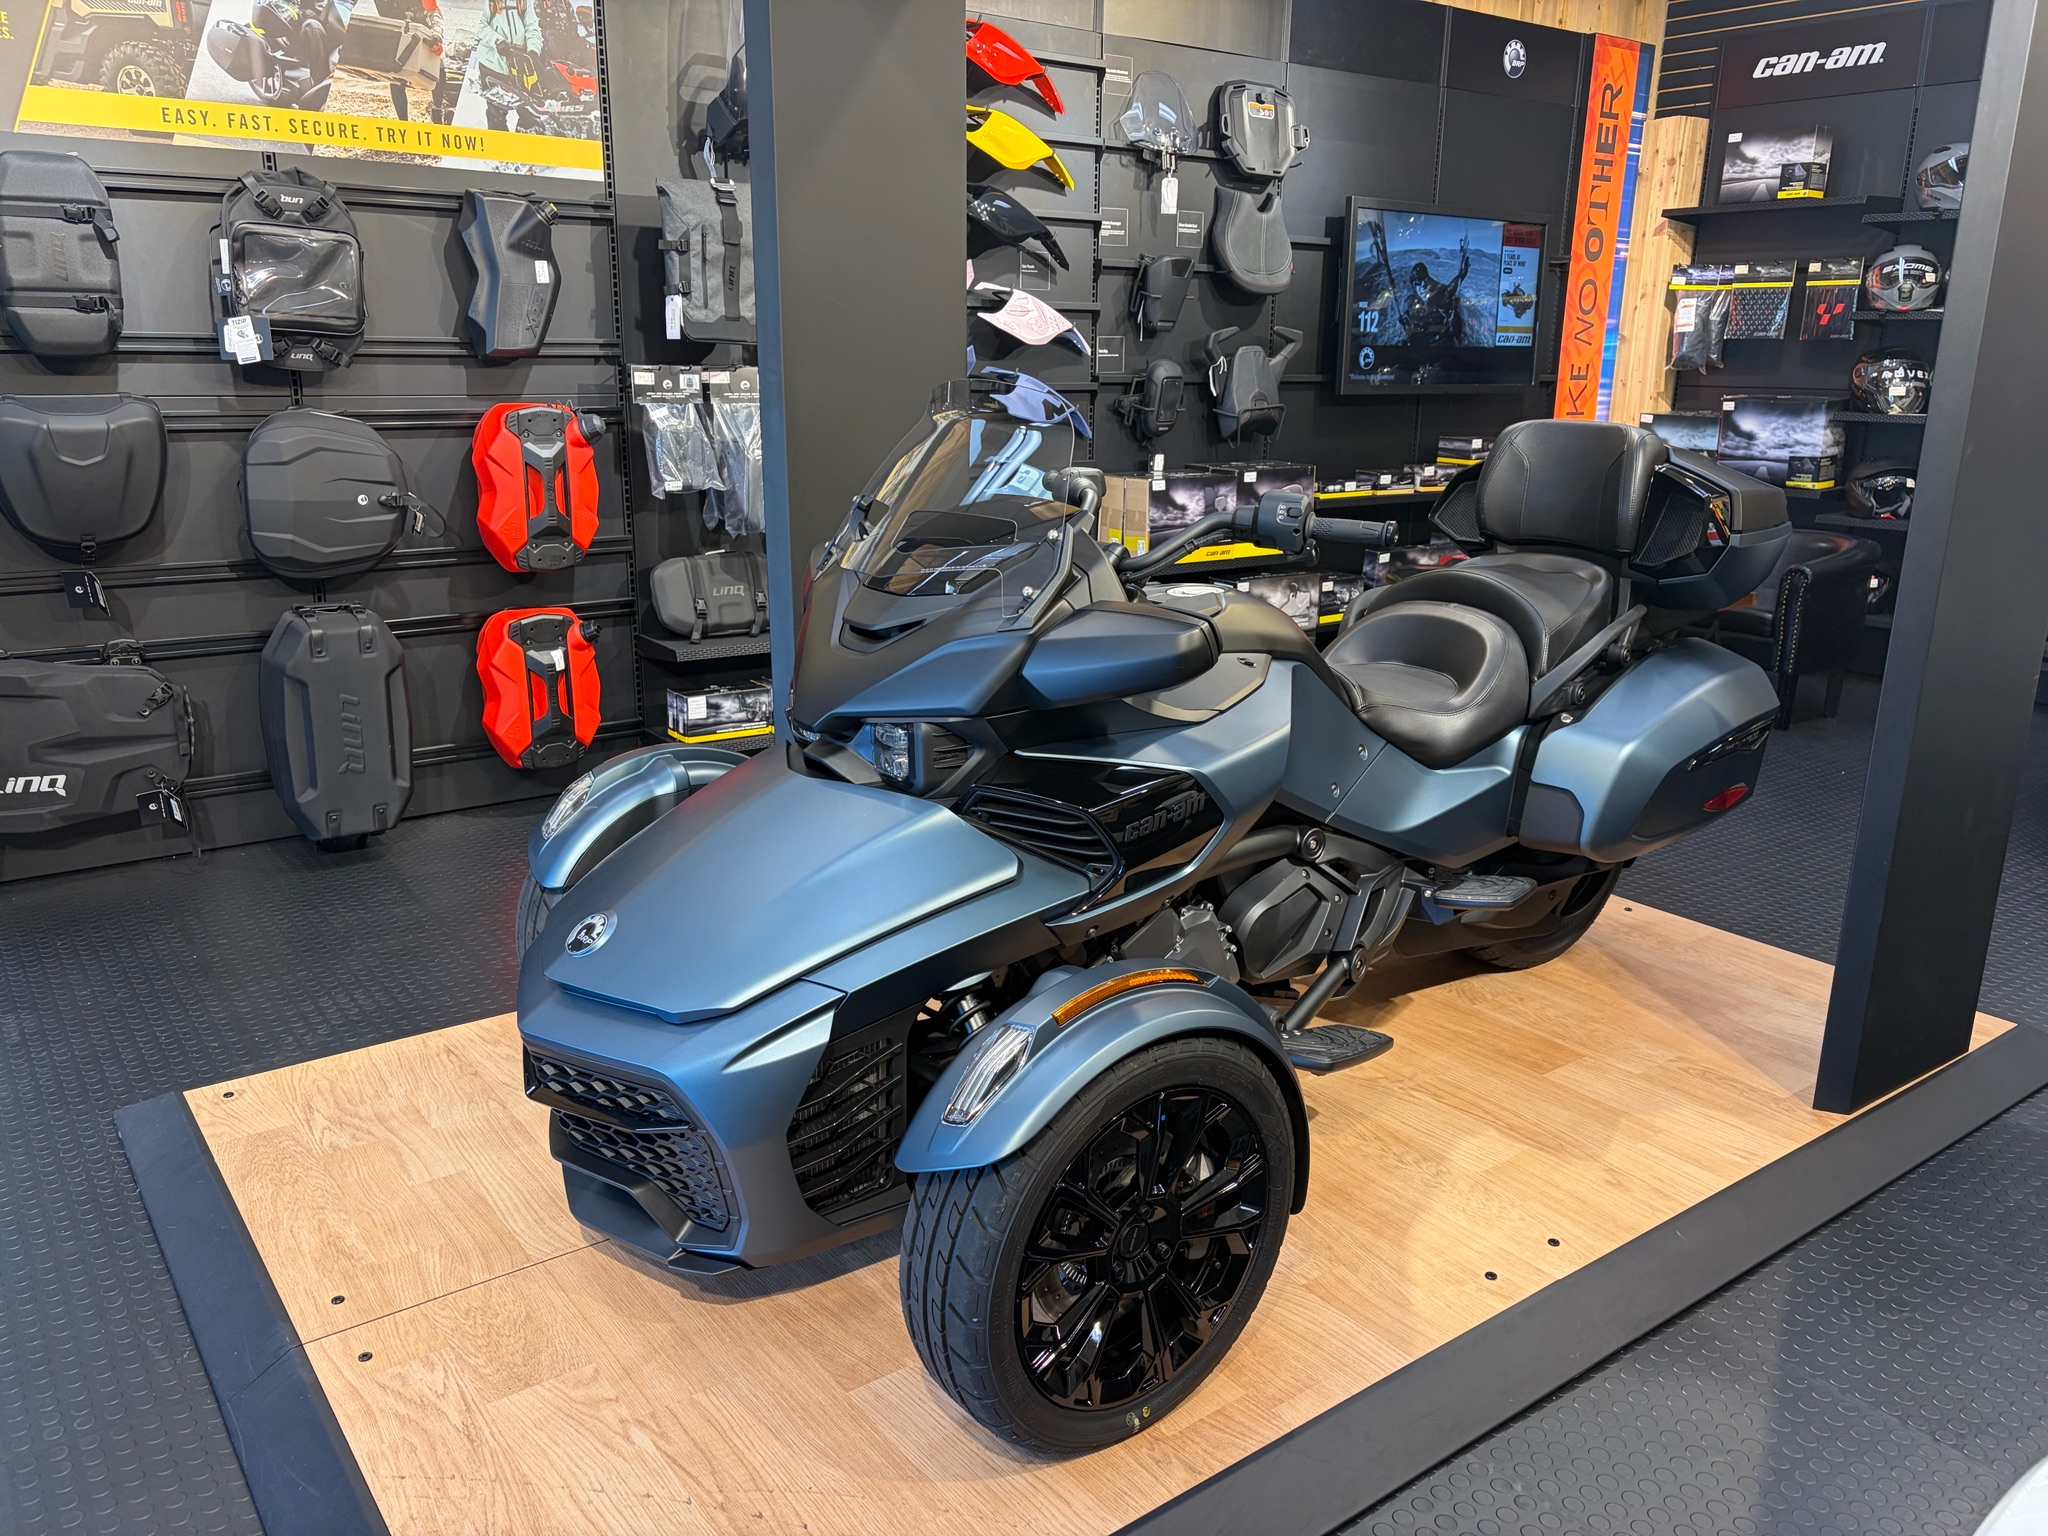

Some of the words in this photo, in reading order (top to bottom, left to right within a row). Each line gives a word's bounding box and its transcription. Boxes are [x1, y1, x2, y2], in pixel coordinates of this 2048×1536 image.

[1752, 41, 1887, 79] can-am
[161, 106, 217, 127] EASY.
[227, 112, 278, 132] FAST.
[288, 118, 367, 141] SECURE.
[376, 126, 407, 144] TRY
[417, 130, 432, 147] IT
[441, 133, 485, 152] NOW!
[1584, 83, 1624, 262] OTHER
[1358, 310, 1379, 333] 112
[1574, 278, 1598, 347] NO
[1497, 334, 1532, 344] can-am
[1206, 549, 1231, 557] can-am
[1125, 793, 1206, 842] can-am
